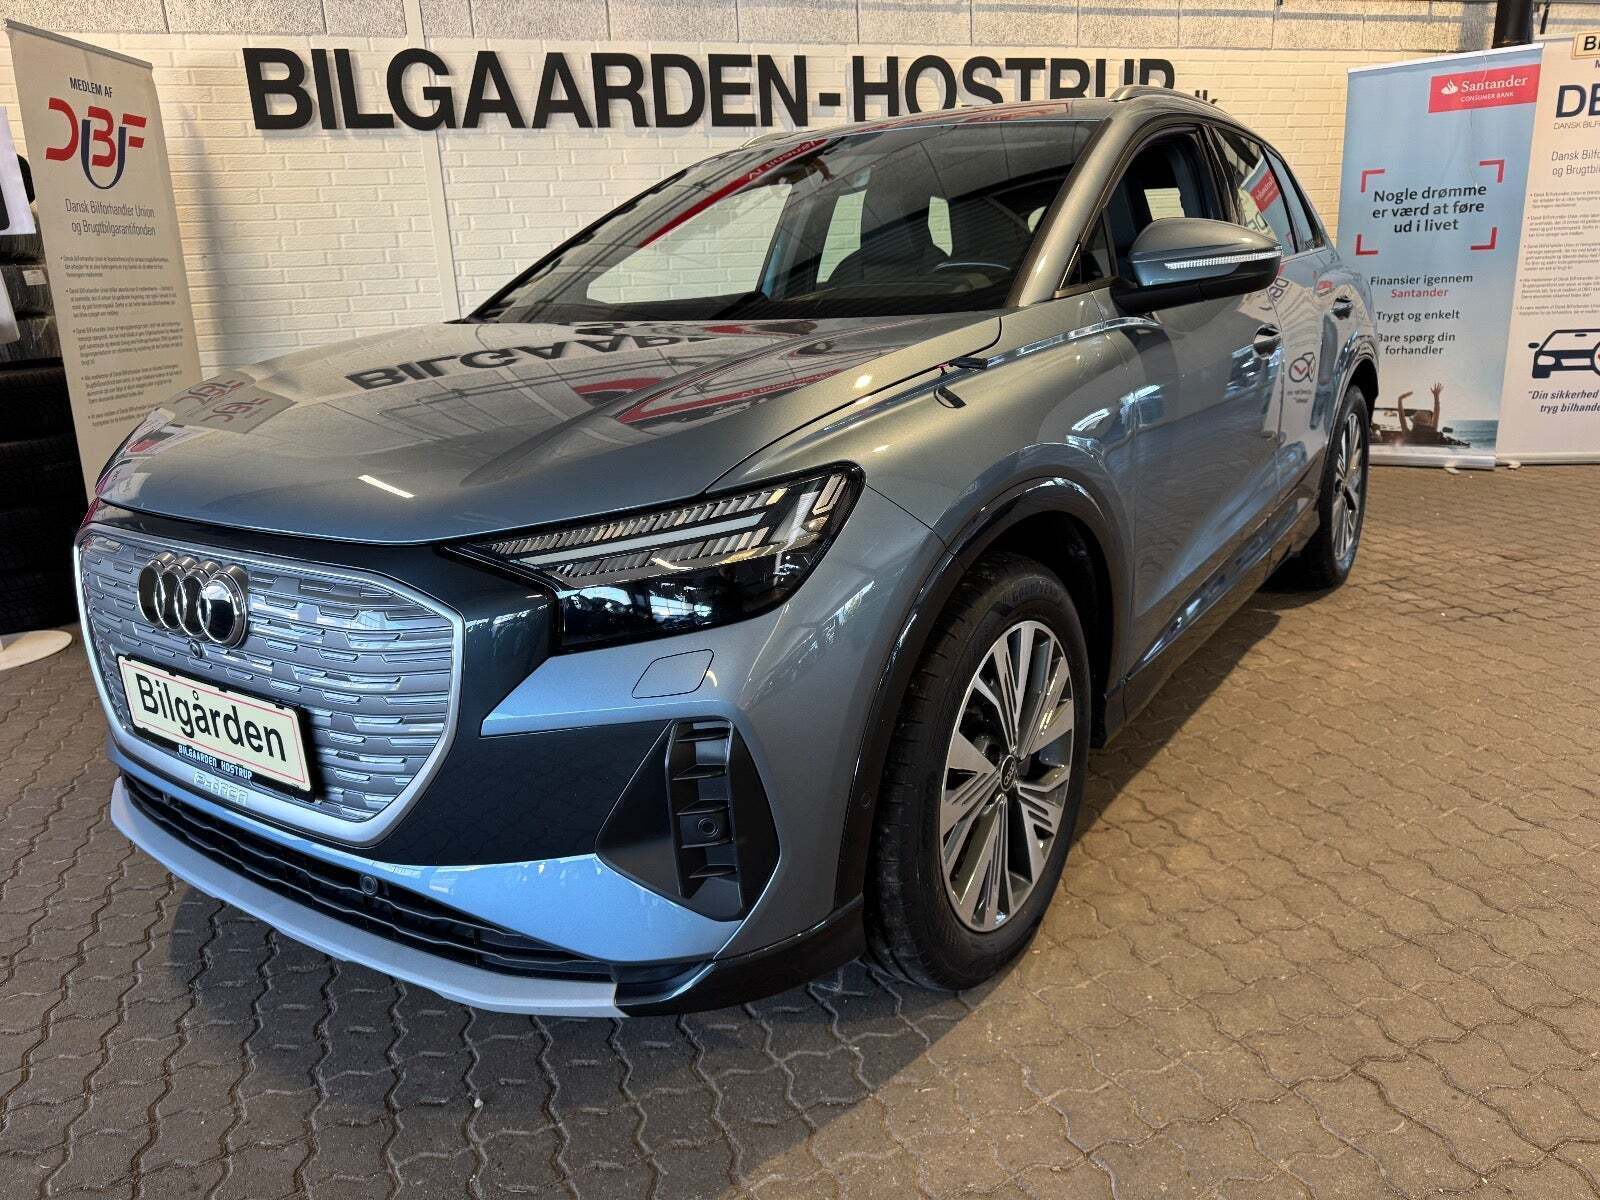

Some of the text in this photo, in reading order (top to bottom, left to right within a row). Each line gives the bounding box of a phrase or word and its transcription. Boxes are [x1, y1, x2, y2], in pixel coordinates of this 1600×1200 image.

[70, 77, 113, 98] MEDLEM AF
[1461, 75, 1528, 92] Santander
[1460, 91, 1514, 103] CONSUMER BANK
[1553, 121, 1581, 130] DANSK
[1552, 151, 1580, 161] Dansk
[1552, 168, 1564, 178] og
[1374, 185, 1487, 205] Nogle drømme
[65, 198, 156, 218] Dansk Bilforhandler Union
[1372, 200, 1485, 219] er værd at føre
[72, 222, 82, 236] og
[1394, 219, 1459, 233] ud i livet
[1370, 275, 1473, 287] Finansier igennem
[1391, 288, 1448, 299] Santander
[1376, 309, 1460, 323] Trygt og enkelt
[1403, 332, 1435, 344] spørg
[1437, 331, 1456, 342] din
[1385, 345, 1444, 355] forhandler
[1550, 389, 1600, 400] sikkerhed
[1540, 404, 1559, 415] tryg
[136, 673, 287, 763] Bilgården
[178, 744, 253, 780] BILGAARDEN HOSTRUP
